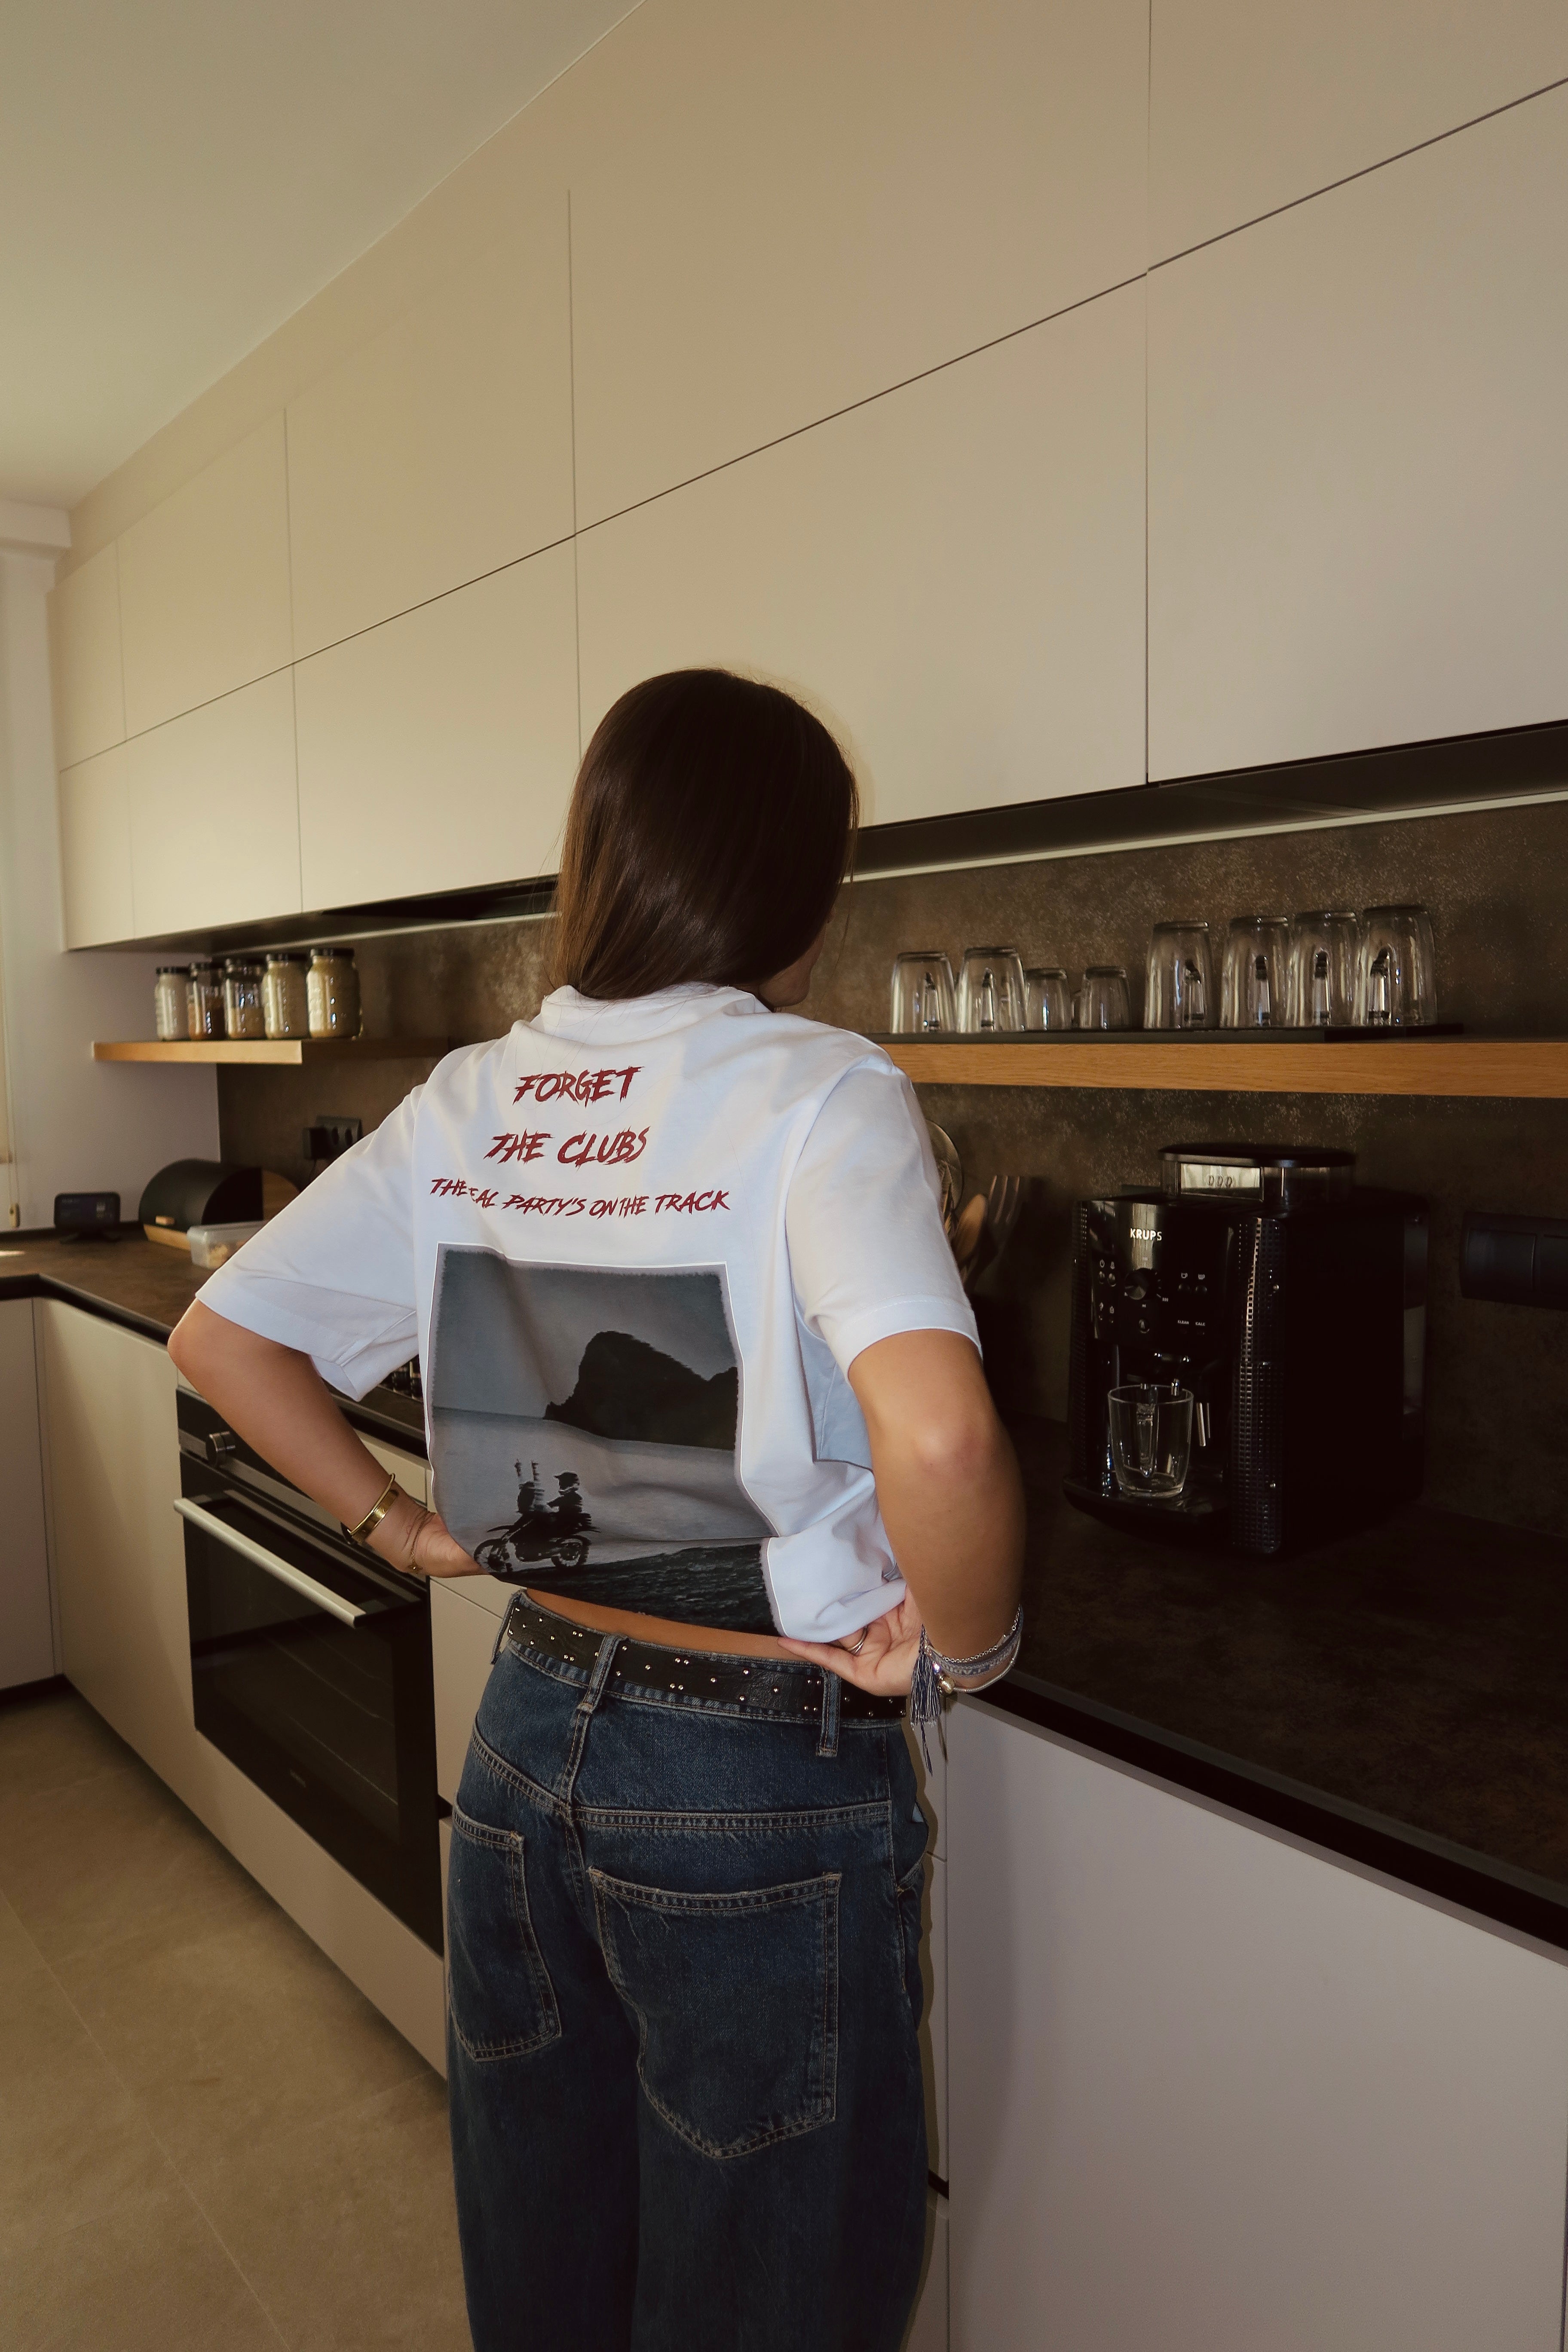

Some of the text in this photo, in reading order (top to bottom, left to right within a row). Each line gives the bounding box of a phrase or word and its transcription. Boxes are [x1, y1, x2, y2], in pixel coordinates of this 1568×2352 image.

[513, 1066, 645, 1108] FORGET
[484, 1126, 650, 1171] THE CLUBS
[430, 1178, 731, 1219] THE EAL PARTY'S ON THE TRACK
[1130, 1228, 1163, 1242] KRUPS
